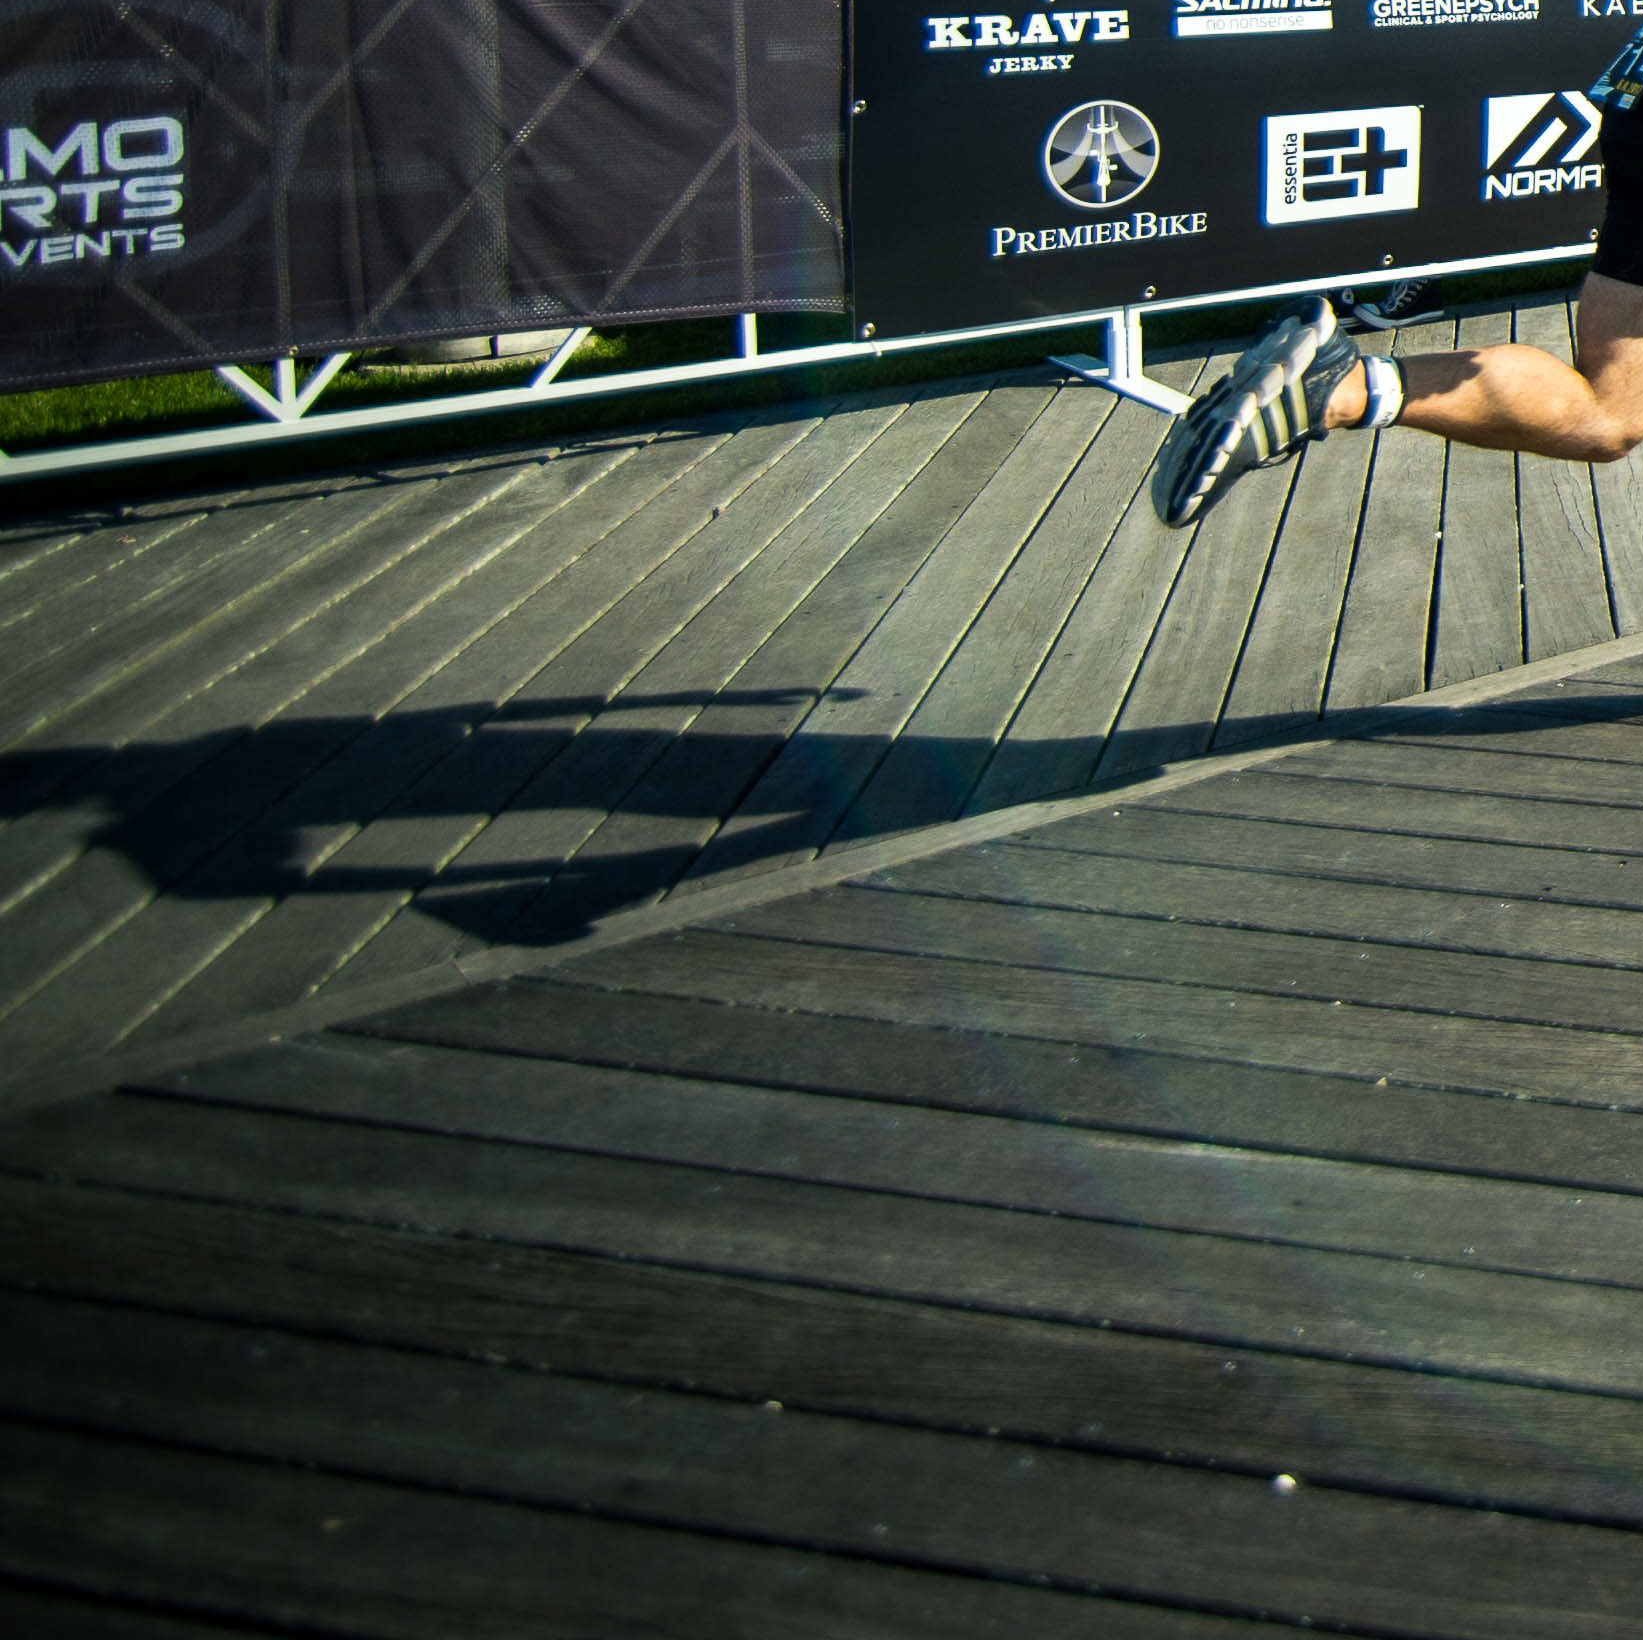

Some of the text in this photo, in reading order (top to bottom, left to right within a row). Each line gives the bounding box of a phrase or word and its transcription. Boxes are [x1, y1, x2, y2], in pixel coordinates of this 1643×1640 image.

[927, 10, 1130, 49] KRAVE
[1229, 13, 1305, 30] nonsense
[1374, 10, 1540, 27] CLINICAL & SPORT PSYCHOLOGY
[989, 54, 1074, 75] JERKY
[0, 116, 185, 182] MO
[1284, 131, 1299, 206] essentia
[1486, 163, 1604, 201] NORMA
